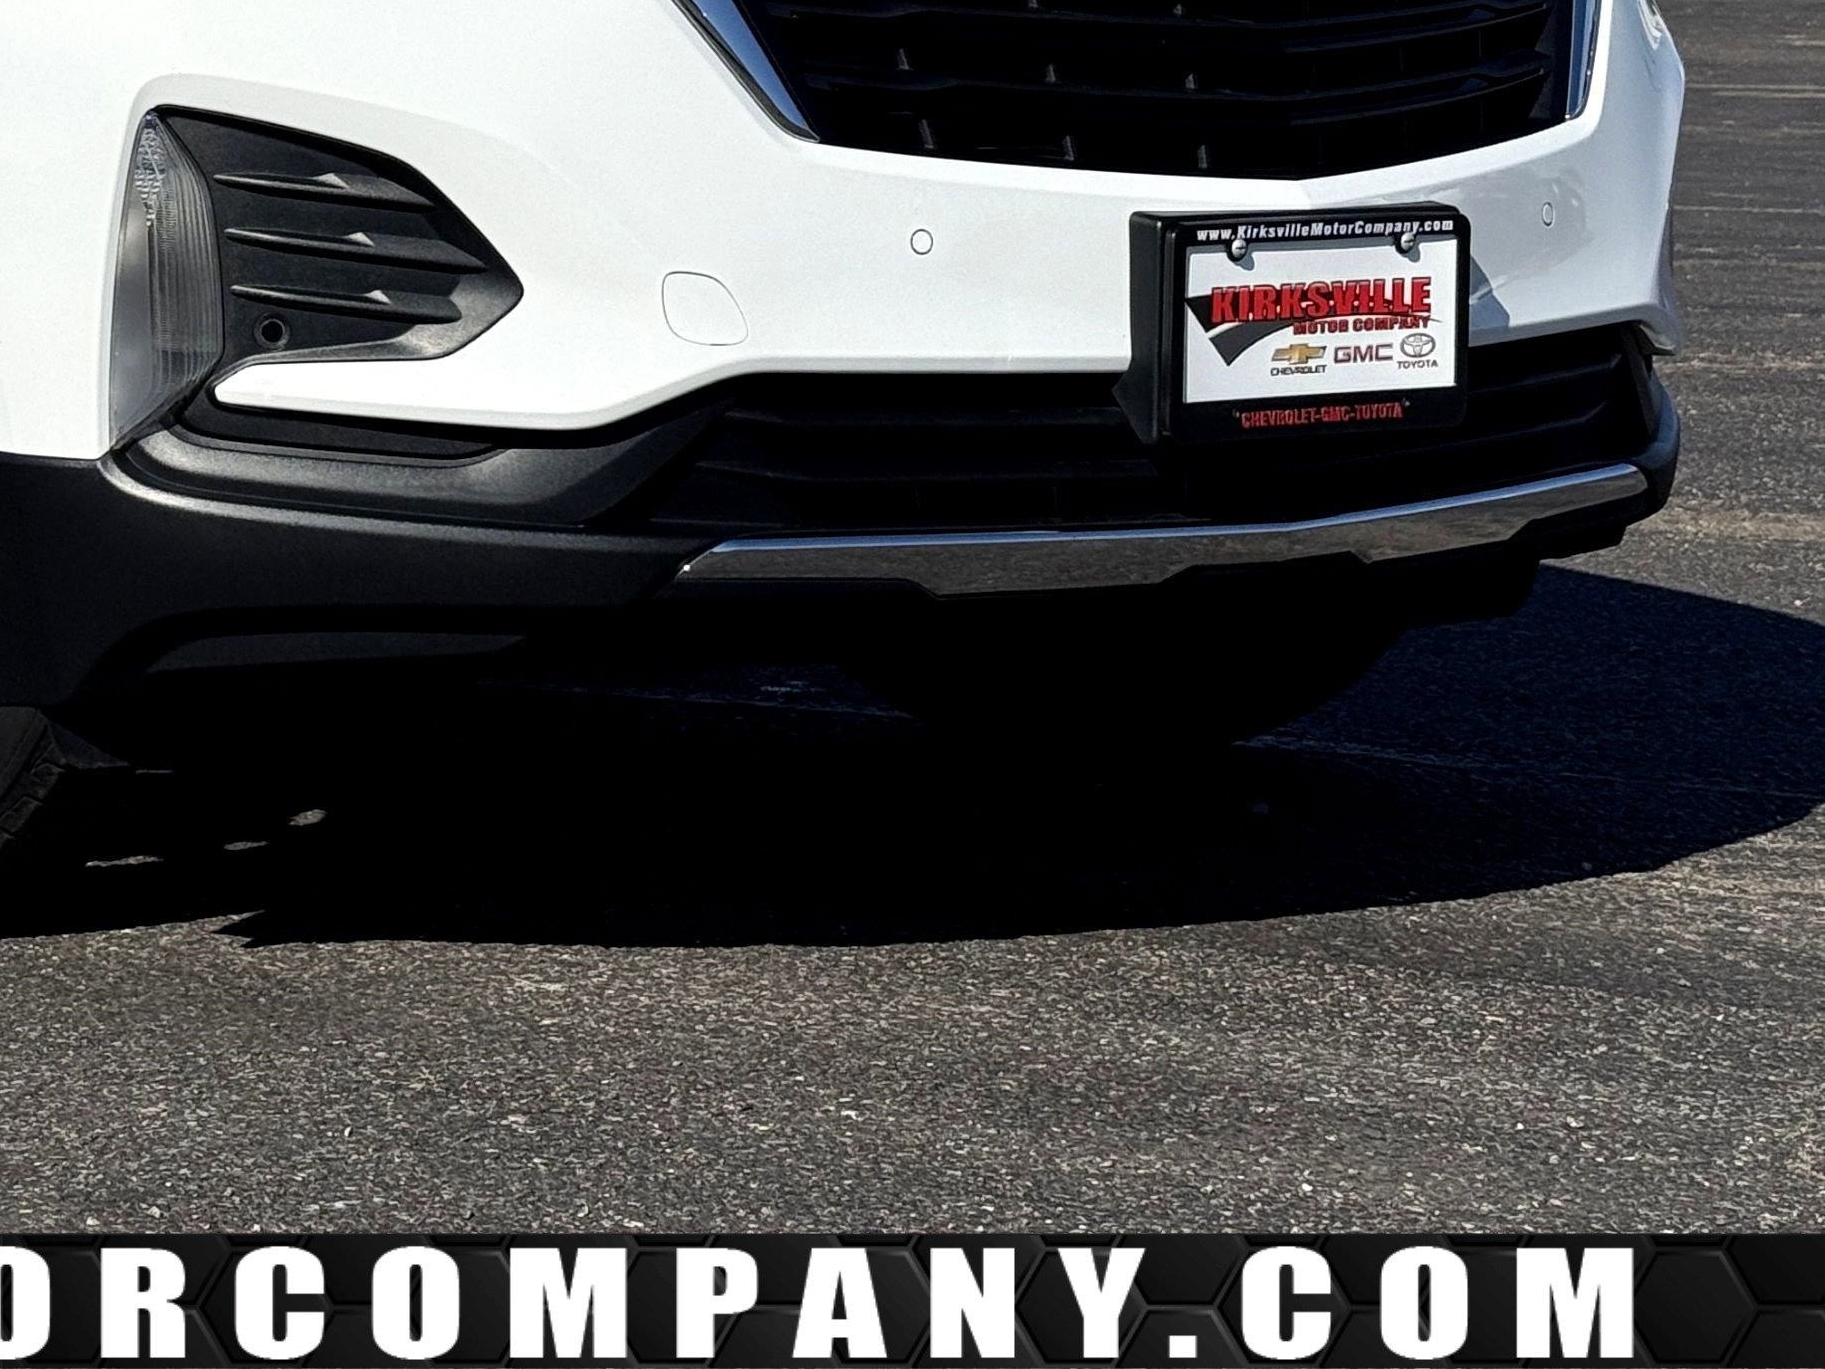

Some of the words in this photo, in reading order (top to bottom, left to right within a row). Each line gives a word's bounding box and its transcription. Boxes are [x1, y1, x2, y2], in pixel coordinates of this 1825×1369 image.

[1210, 276, 1432, 323] KIRKSVILLE
[1292, 319, 1349, 336] MOTOR
[1352, 314, 1431, 332] COMPANY
[1270, 364, 1328, 376] CHEVROLET
[1334, 343, 1394, 364] GMC
[1397, 359, 1439, 370] TOYOTA
